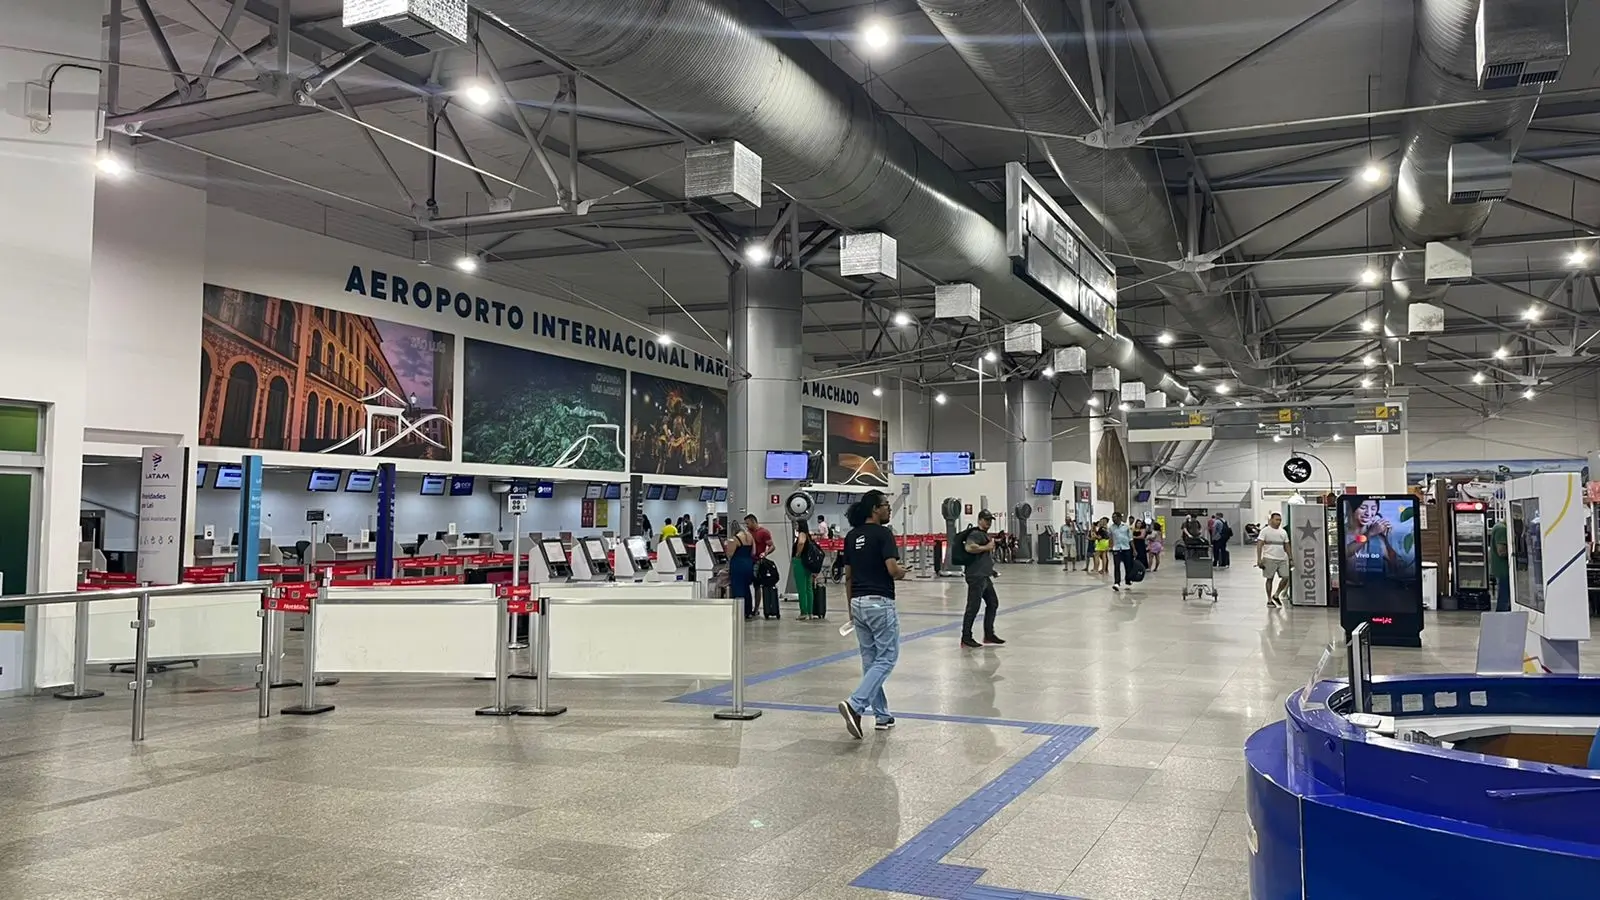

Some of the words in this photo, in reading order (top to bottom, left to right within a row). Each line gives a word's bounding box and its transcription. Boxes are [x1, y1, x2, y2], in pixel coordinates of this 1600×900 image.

[344, 265, 524, 331] AEROPORTO
[533, 311, 689, 369] INTERNACIONAL
[812, 381, 860, 406] MACHADO
